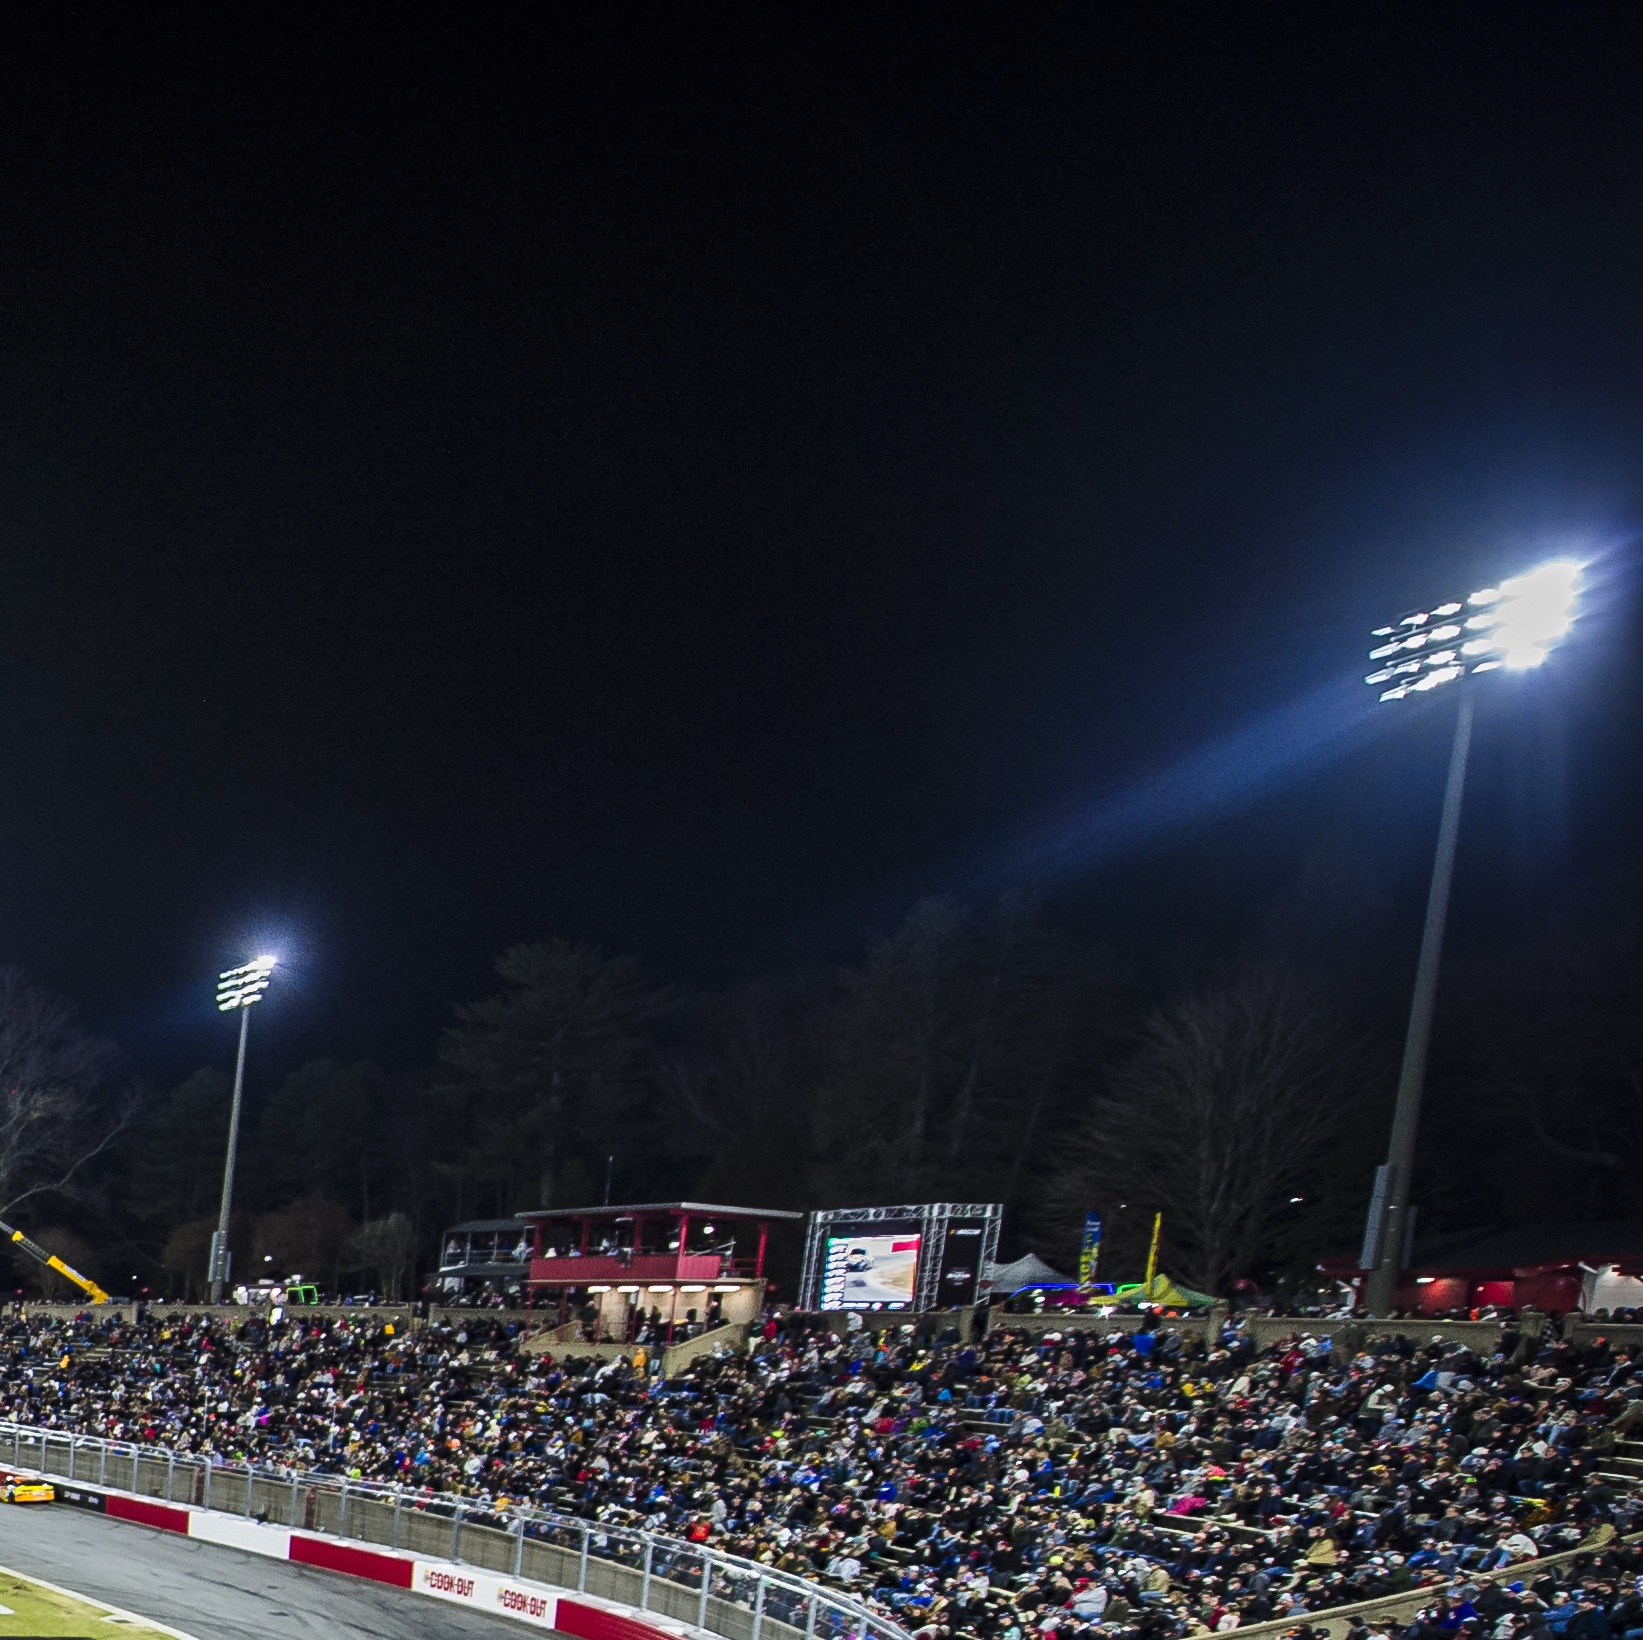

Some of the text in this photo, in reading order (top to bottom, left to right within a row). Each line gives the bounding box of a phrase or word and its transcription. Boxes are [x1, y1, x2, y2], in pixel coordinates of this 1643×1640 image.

[430, 1571, 475, 1597] COOK OUT
[503, 1590, 548, 1618] COOK OUT
